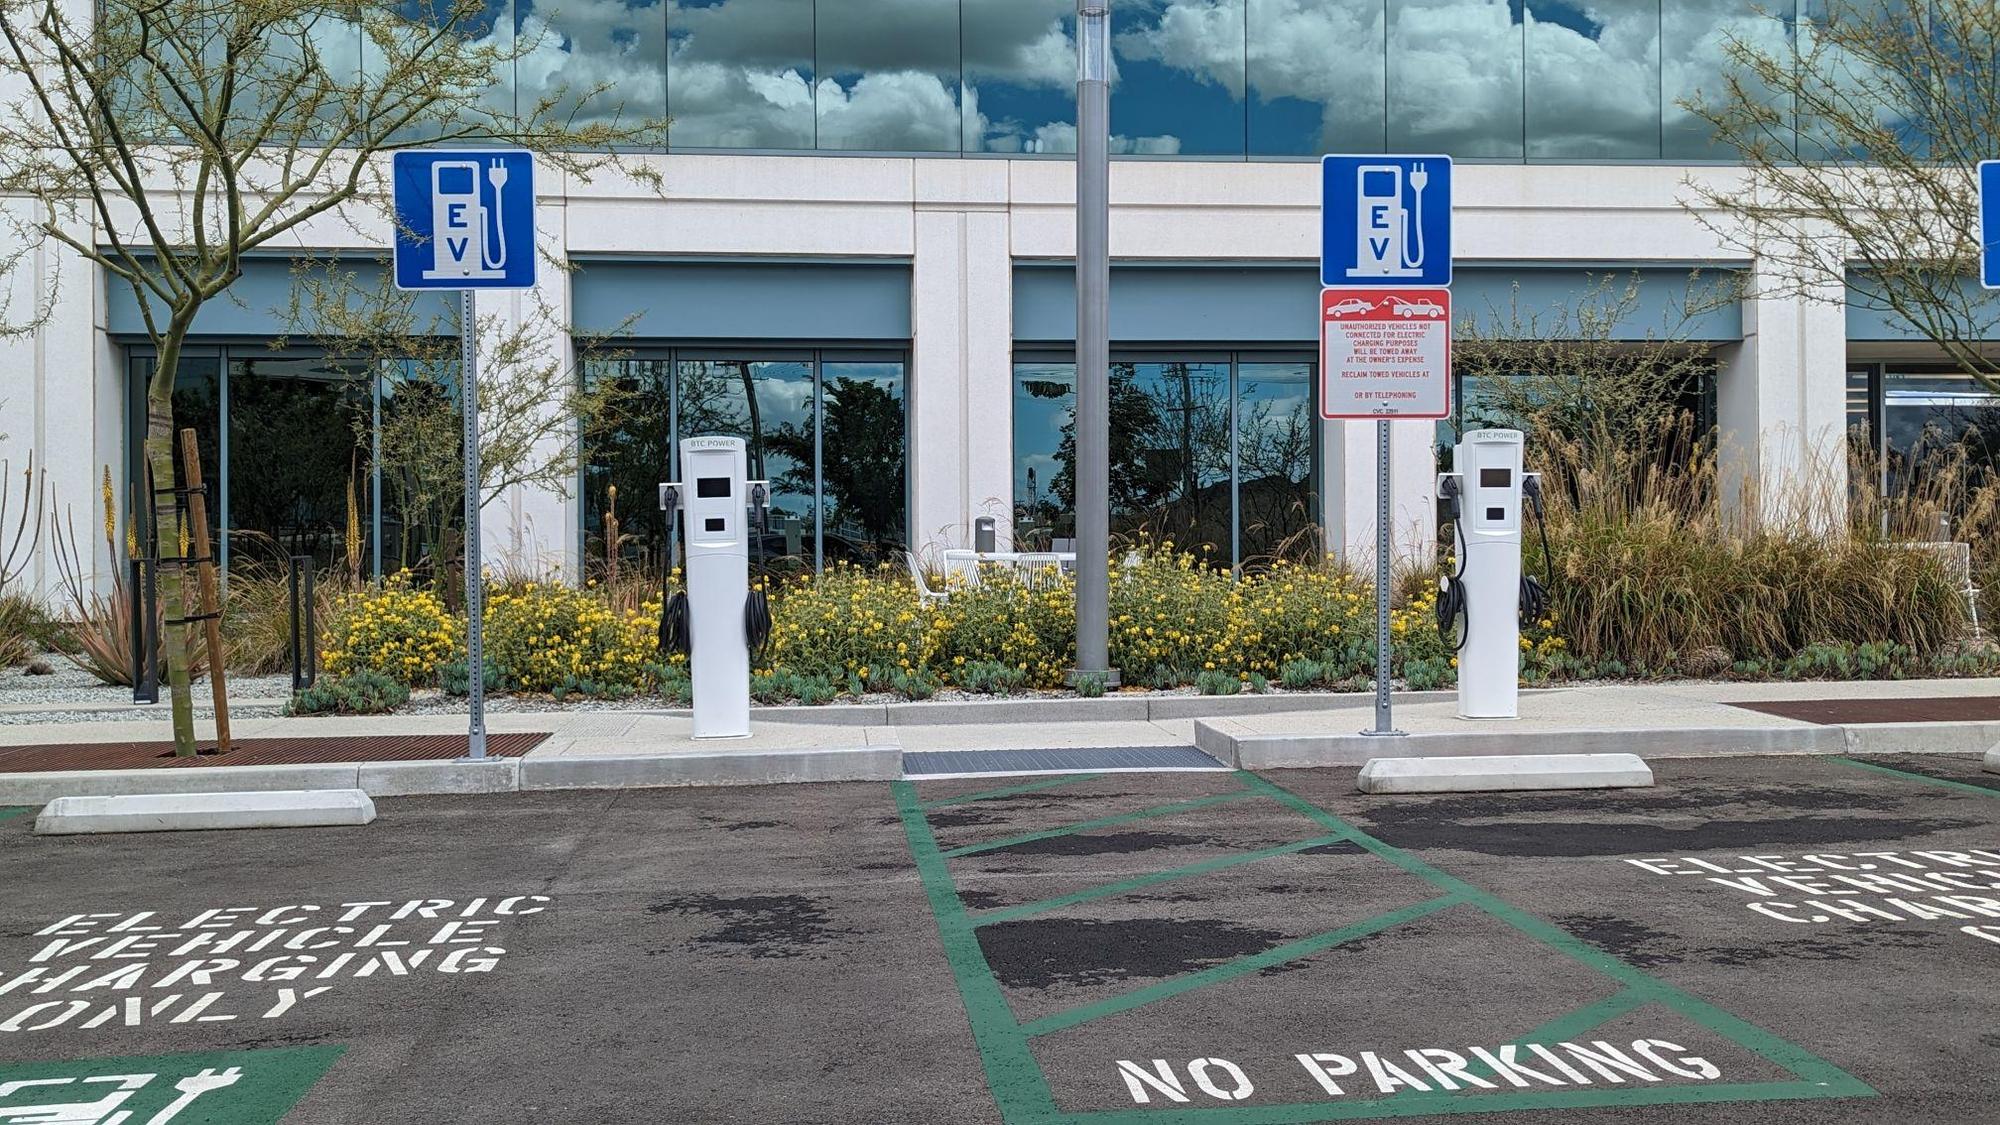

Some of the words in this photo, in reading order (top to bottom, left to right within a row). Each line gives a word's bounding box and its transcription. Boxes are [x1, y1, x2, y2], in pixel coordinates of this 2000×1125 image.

[1354, 391, 1363, 399] OR
[1364, 391, 1373, 399] BY
[1374, 391, 1417, 399] TELEPHONING
[35, 895, 551, 936] ELECTRIC
[29, 920, 500, 962] VEHICLE
[0, 947, 507, 995] HARGING
[0, 987, 333, 1031] ONLY
[1115, 1057, 1255, 1104] NO
[1296, 1039, 1721, 1096] PARKING
